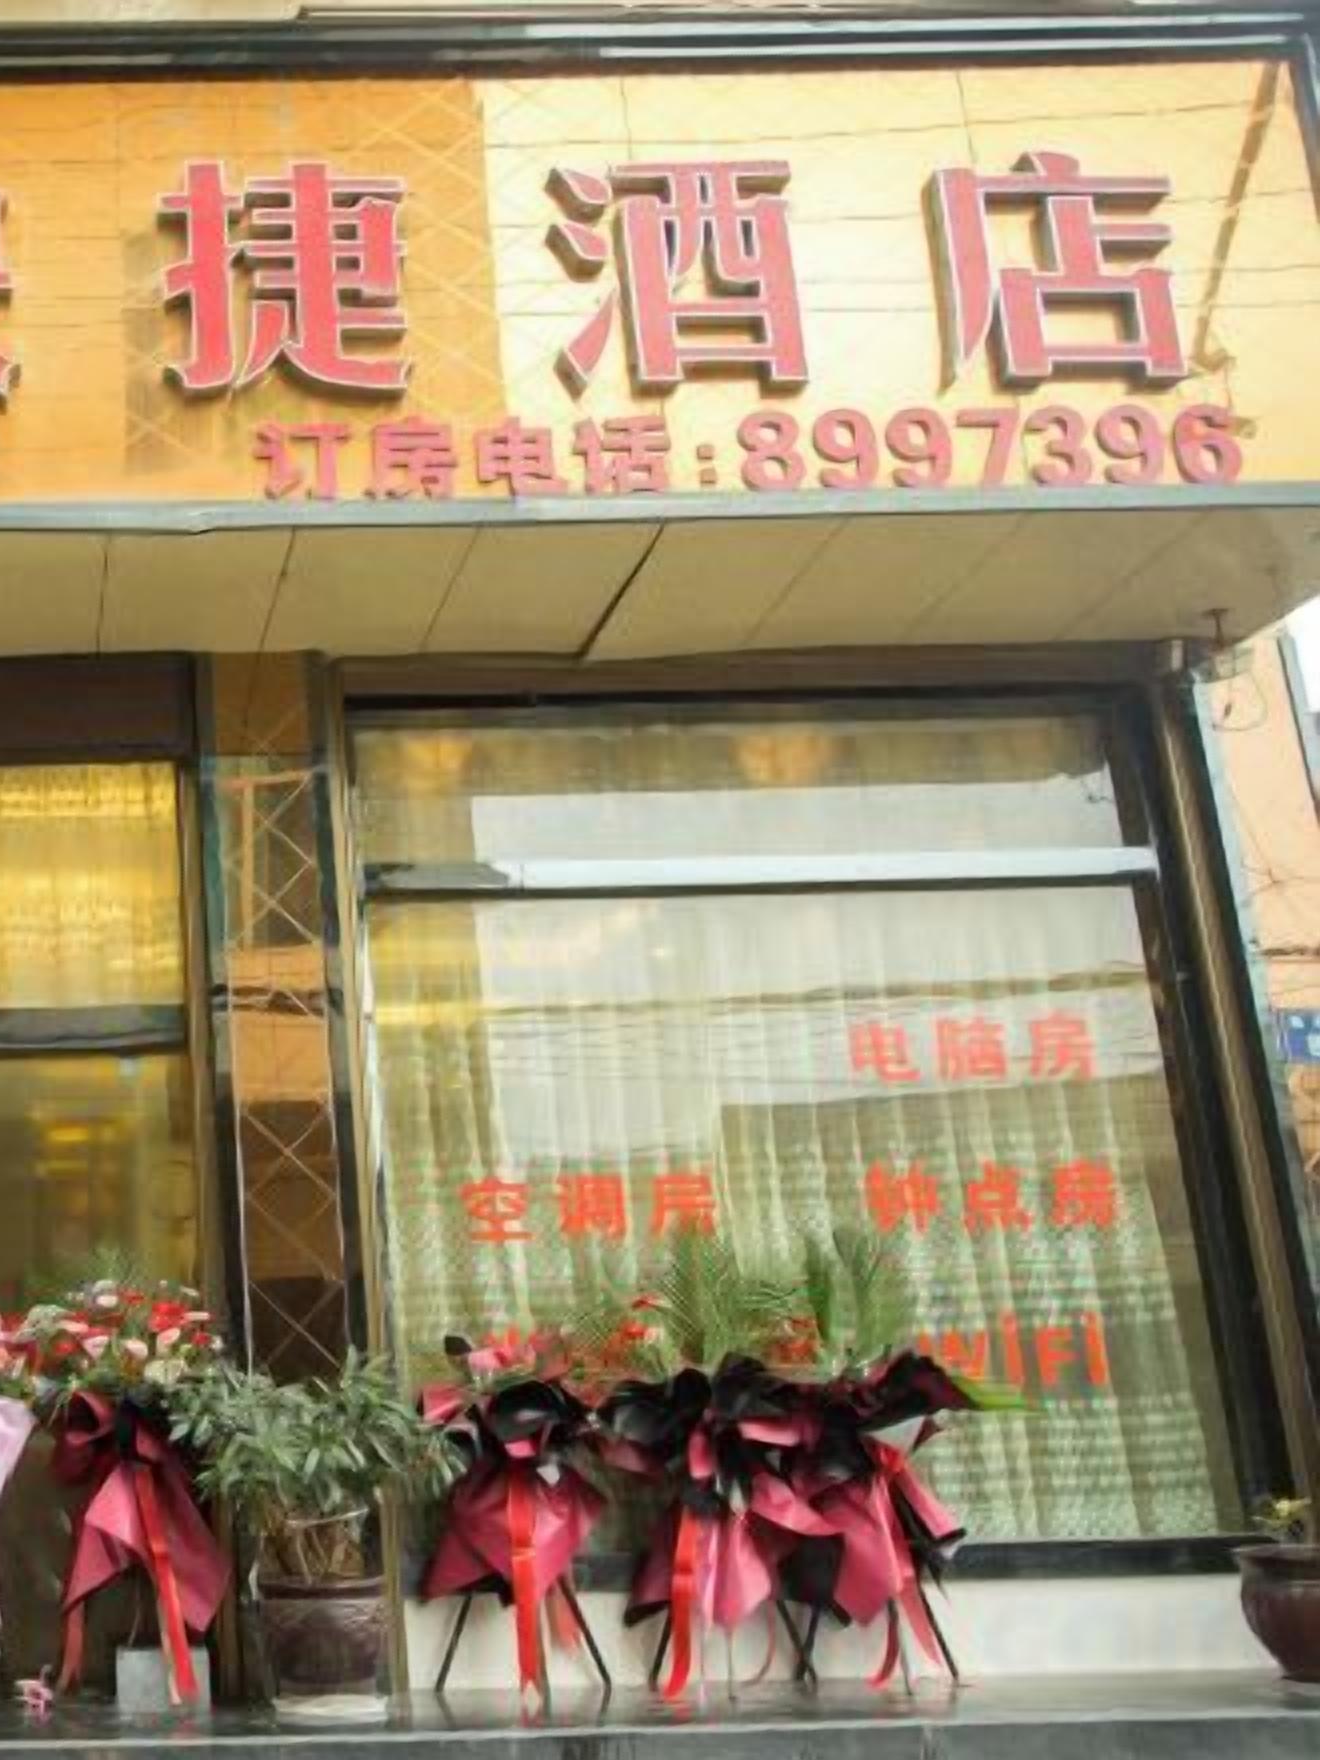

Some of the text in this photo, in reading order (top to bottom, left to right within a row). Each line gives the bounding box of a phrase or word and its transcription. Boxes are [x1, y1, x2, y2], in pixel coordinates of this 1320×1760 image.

[848, 1010, 1096, 1084] 电脑房
[459, 1172, 718, 1244] 空调房
[865, 1157, 1115, 1234] 钟点房
